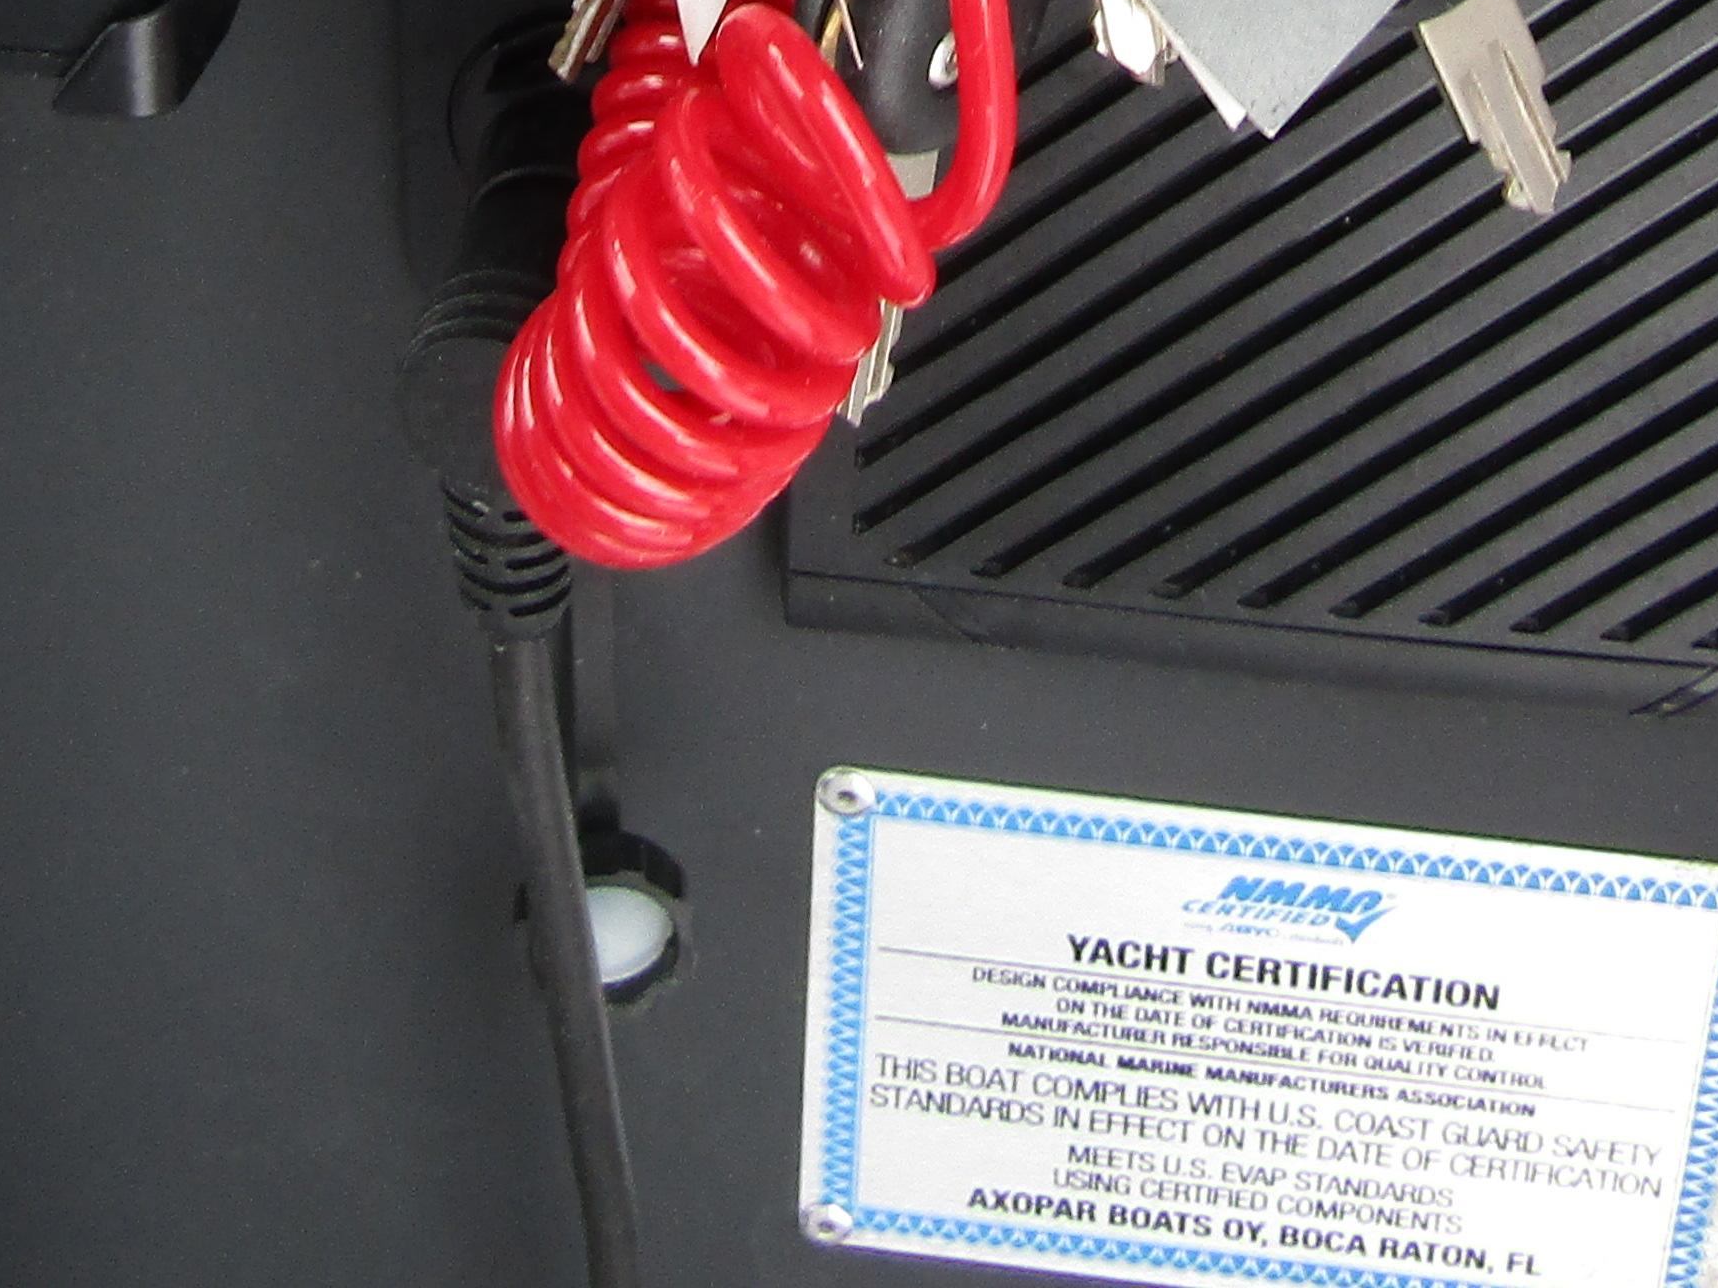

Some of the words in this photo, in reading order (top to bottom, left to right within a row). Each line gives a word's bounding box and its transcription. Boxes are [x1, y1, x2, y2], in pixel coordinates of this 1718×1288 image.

[1182, 898, 1331, 927] CERTIFIED
[972, 967, 1045, 990] DESIGN
[1053, 976, 1182, 1006] COMPLIANCE
[1189, 992, 1239, 1012] WITH
[1247, 998, 1313, 1021] NMMA
[1319, 1007, 1479, 1041] REQUIREMENTS
[1487, 1026, 1506, 1044] IN
[1513, 1029, 1587, 1053] EFFECT
[1067, 933, 1194, 975] YACHT
[1205, 950, 1499, 1011] CERTIFICATION
[1001, 1011, 1165, 1045] MANUFACTURER
[1173, 1031, 1309, 1062] RESPONSIBLE
[1317, 1047, 1357, 1067] FOR
[1364, 1052, 1448, 1077] QUALITY
[1453, 1062, 1544, 1088] CONTROL
[1057, 997, 1085, 1015] ON
[1092, 1001, 1127, 1020] THE
[1135, 1006, 1184, 1027] DATE
[1191, 1012, 1215, 1030] OF
[1223, 1016, 1371, 1048] CERTIFICATION
[1379, 1034, 1397, 1051] IS
[875, 1054, 937, 1086] THIS
[946, 1062, 1021, 1095] BOAT
[1033, 1071, 1177, 1113] COMPLIES
[1187, 1089, 1259, 1122] WITH
[1269, 1098, 1322, 1129] U.S.
[1335, 1106, 1432, 1142] COAST
[1441, 1118, 1543, 1154] GUARD
[1552, 1130, 1662, 1168] SAFETY
[1007, 1041, 1108, 1069] NATIONAL
[1116, 1054, 1197, 1079] MARINE
[1204, 1065, 1389, 1101] MANUFACTURERS
[1396, 1088, 1535, 1117] ASSOCIATION
[869, 1082, 1043, 1128] STANDARDS
[1053, 1103, 1079, 1132] IN
[1089, 1107, 1195, 1145] EFFECT
[1203, 1120, 1245, 1151] ON
[1255, 1126, 1307, 1158] THE
[1317, 1133, 1393, 1168] DATE
[1402, 1143, 1441, 1173] OF
[1449, 1148, 1661, 1198] CERTIFICATION
[1067, 1143, 1156, 1174] MEETS
[1163, 1154, 1211, 1179] U.S.
[1221, 1161, 1287, 1187] EVAP
[1294, 1170, 1452, 1207] STANDARDS
[966, 1187, 1097, 1224] AXOPAR
[1108, 1203, 1212, 1238] BOATS
[1222, 1218, 1267, 1248] OY,
[1278, 1224, 1367, 1257] BOCA
[1378, 1236, 1493, 1274] RATON,
[1506, 1252, 1539, 1275] FL
[1053, 1167, 1131, 1196] USING
[1139, 1177, 1268, 1211] CERTIFIED
[1276, 1194, 1461, 1233] COMPONENTS
